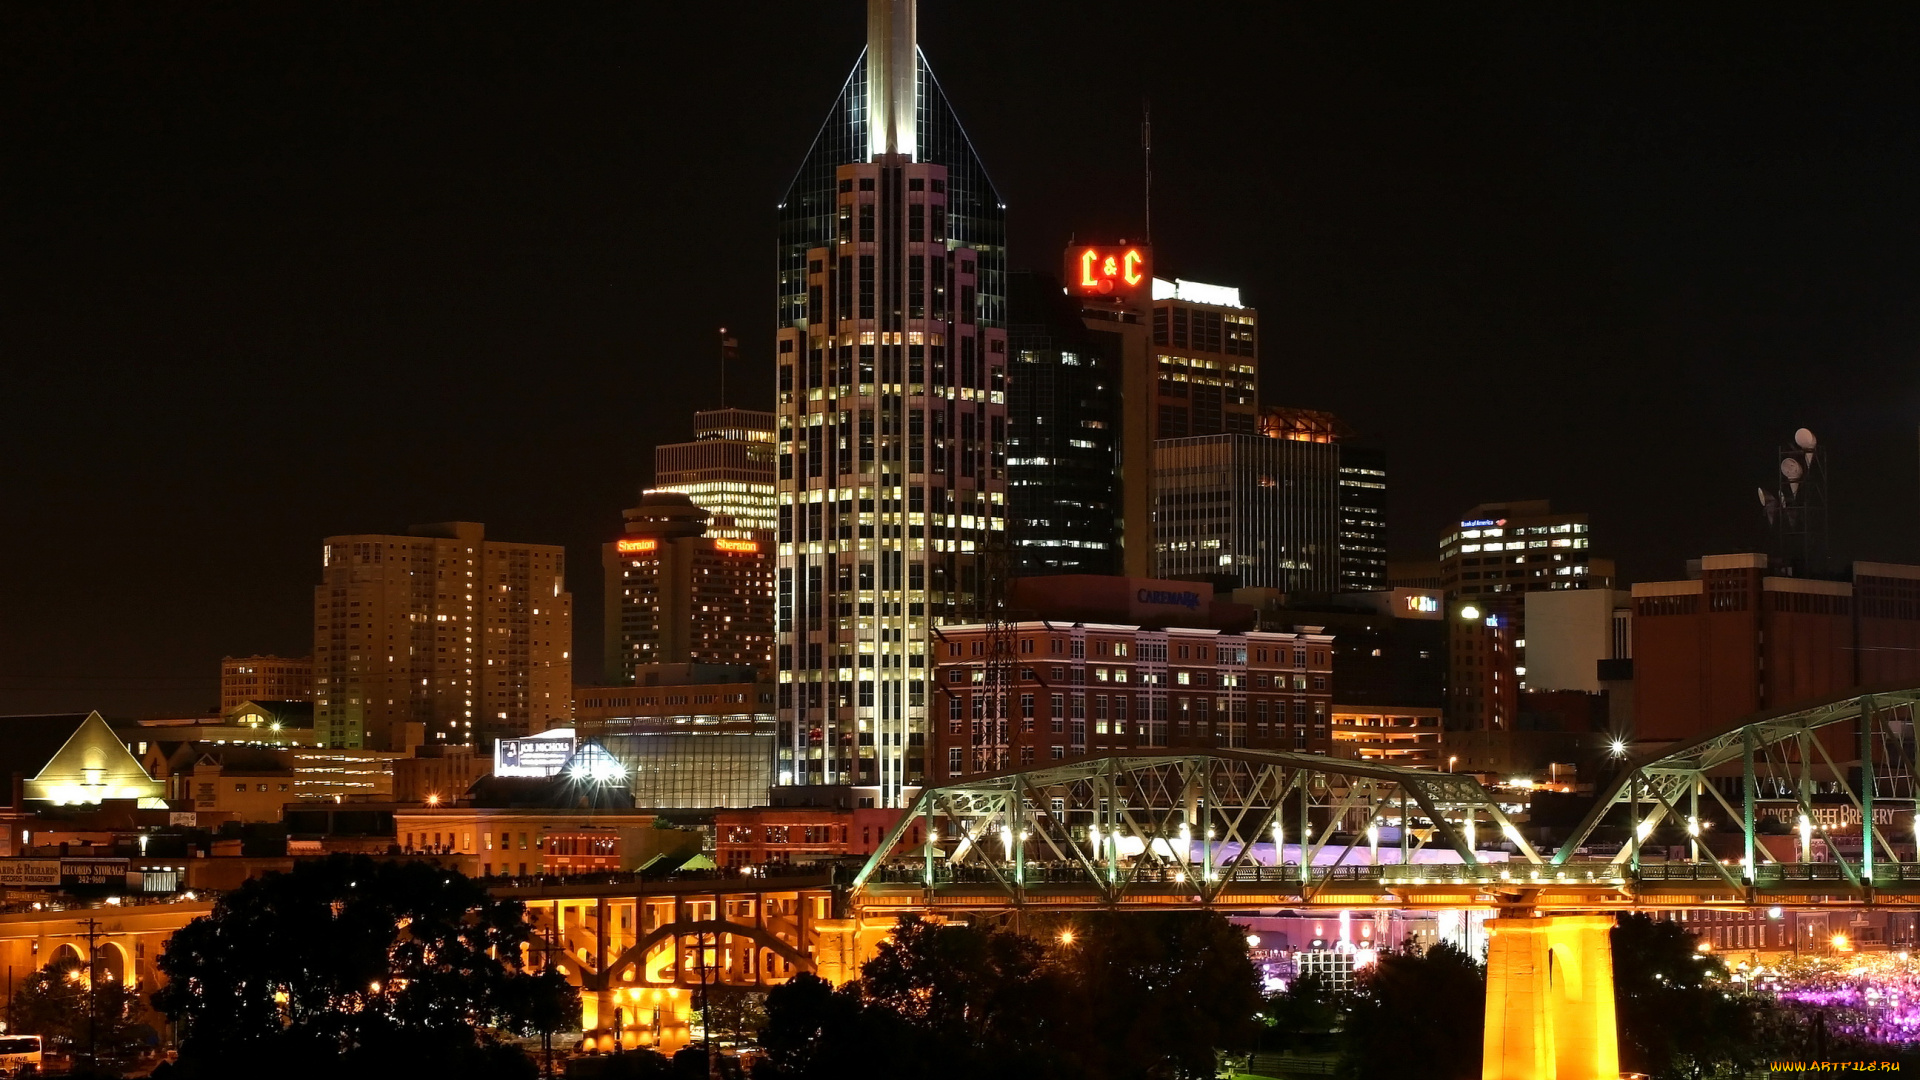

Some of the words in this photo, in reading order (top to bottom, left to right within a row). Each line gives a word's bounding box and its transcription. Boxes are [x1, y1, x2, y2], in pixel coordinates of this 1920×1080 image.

[618, 539, 655, 551] Sheraton
[716, 539, 757, 551] Sheraton
[520, 743, 534, 754] JOE
[535, 742, 569, 752] NICHOLS
[1753, 804, 1794, 824] ARKET
[1797, 804, 1839, 825] SREET
[1840, 804, 1895, 825] BREERY
[16, 863, 23, 875] &
[62, 865, 92, 875] RECORDS
[94, 864, 126, 876] STORAGE
